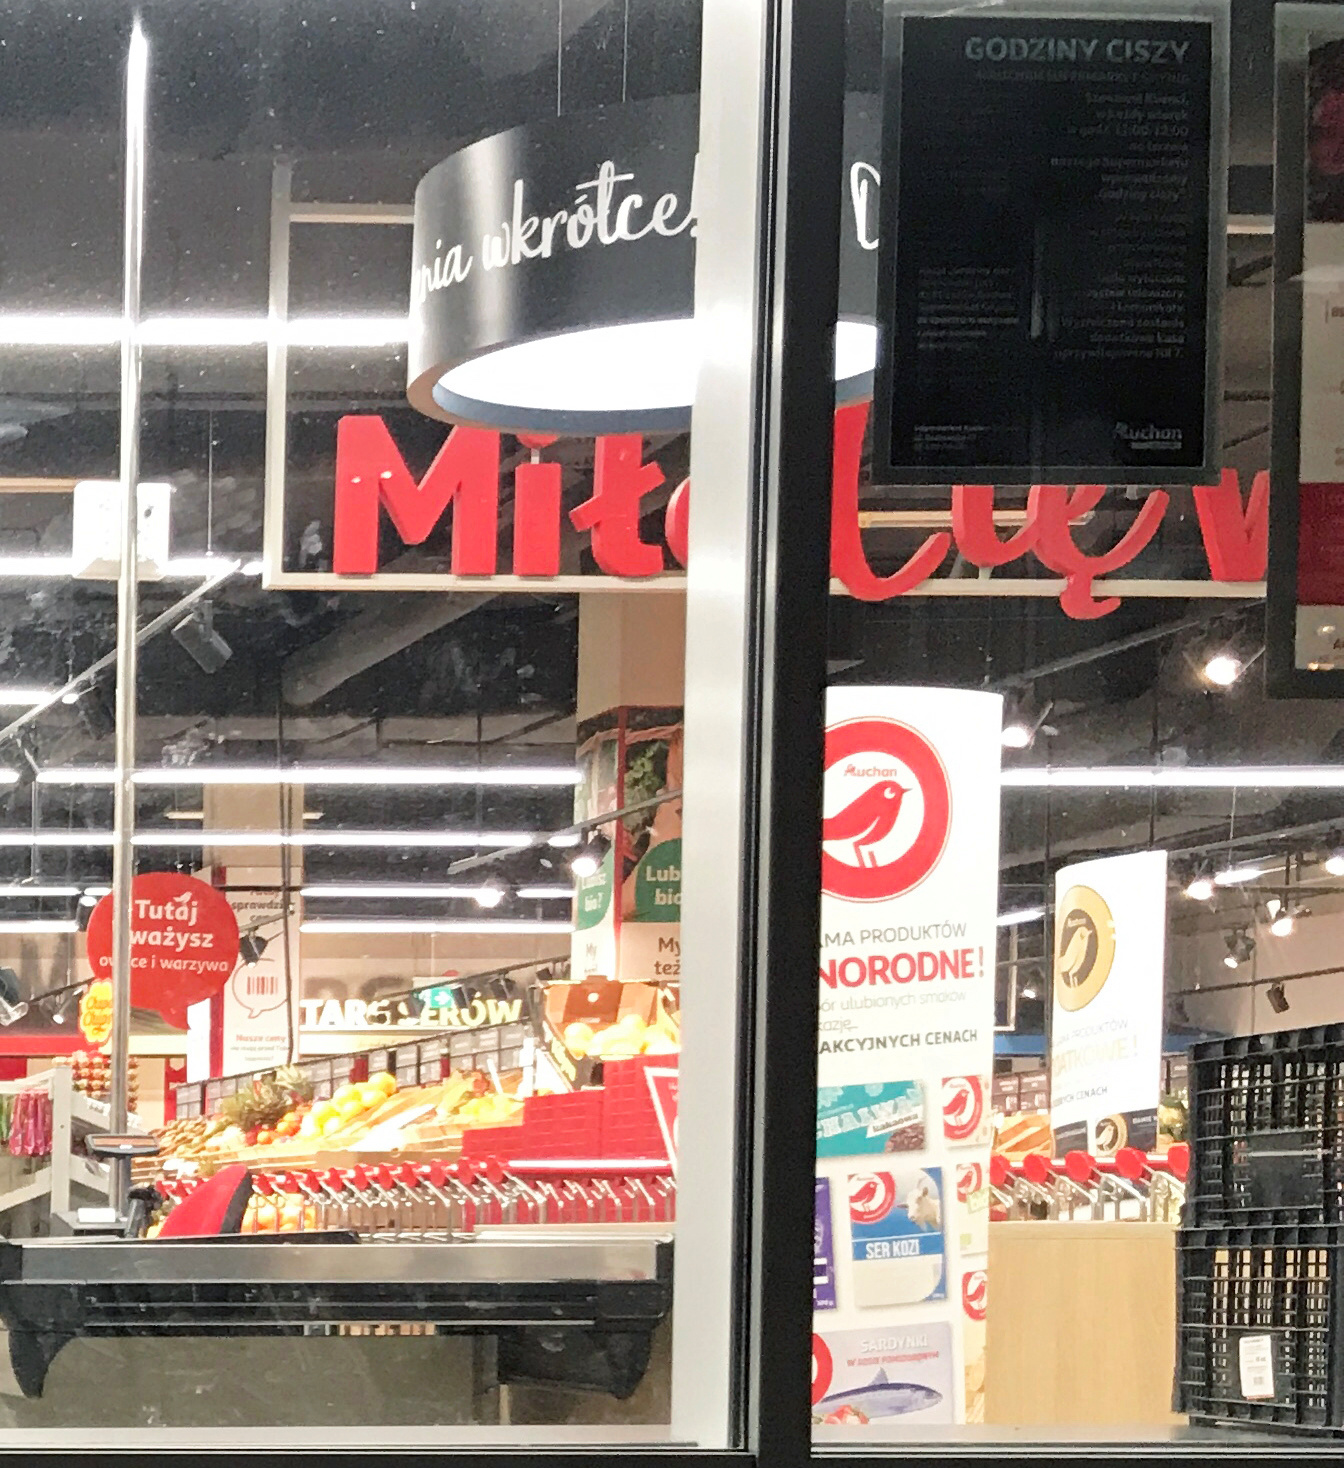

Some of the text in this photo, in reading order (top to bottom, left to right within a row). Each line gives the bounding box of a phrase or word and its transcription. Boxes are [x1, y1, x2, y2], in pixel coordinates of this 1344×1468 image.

[965, 37, 1191, 65] GODZINY CISZY
[334, 413, 689, 578] Mił
[844, 763, 897, 778] Auchan
[646, 866, 680, 882] Lub
[135, 894, 199, 926] Tutaj
[130, 926, 214, 952] ważysz
[819, 920, 968, 949] MA PRODUKTÓW
[99, 954, 230, 974] oce i warzywa
[818, 945, 985, 989] NORODNE!
[818, 999, 836, 1013] ór
[840, 994, 916, 1011] ulubionych
[819, 1029, 978, 1055] AKCYJNYCH CENACH
[866, 1238, 920, 1259] SER KOZI
[861, 1334, 928, 1354] SARDYNKI
